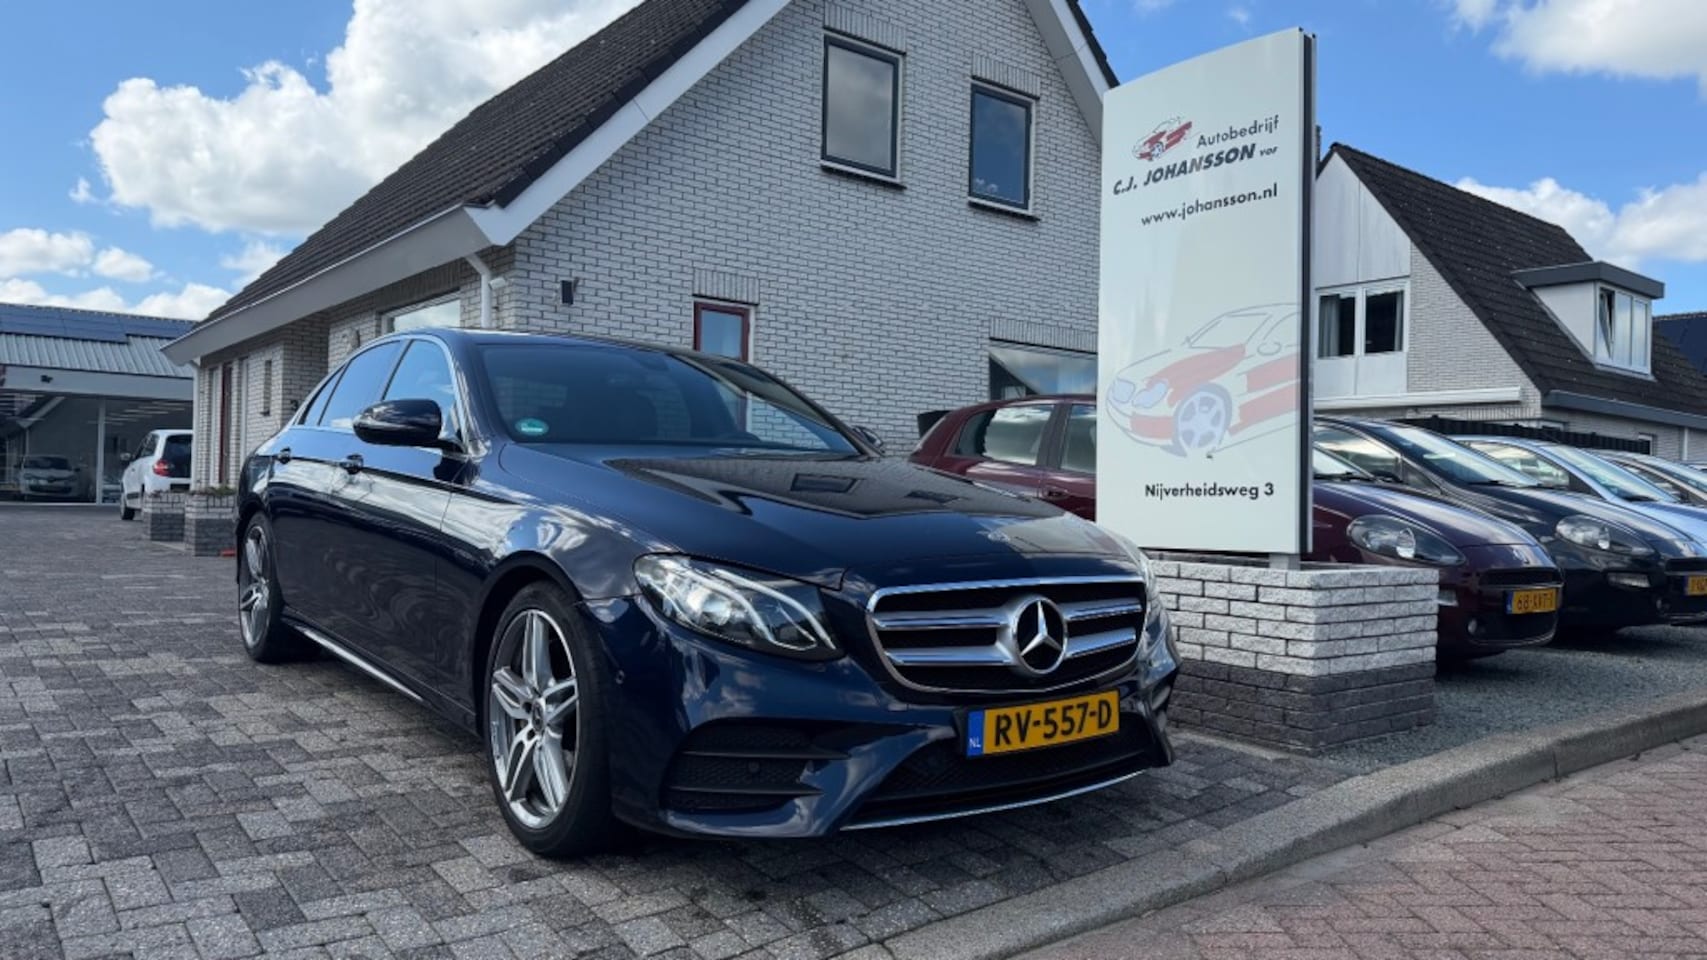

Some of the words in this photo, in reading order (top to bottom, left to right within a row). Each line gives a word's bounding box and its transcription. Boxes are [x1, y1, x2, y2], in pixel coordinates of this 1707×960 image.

[1197, 115, 1279, 148] Autobedrijf
[1113, 176, 1137, 195] C.J.
[1144, 143, 1256, 186] JOHANSSON
[1141, 183, 1278, 226] www.johansson.nl
[1145, 481, 1259, 500] Nijverheidsweg
[1264, 482, 1274, 496] 3
[969, 736, 982, 748] NL
[995, 699, 1112, 746] RV-557-D
